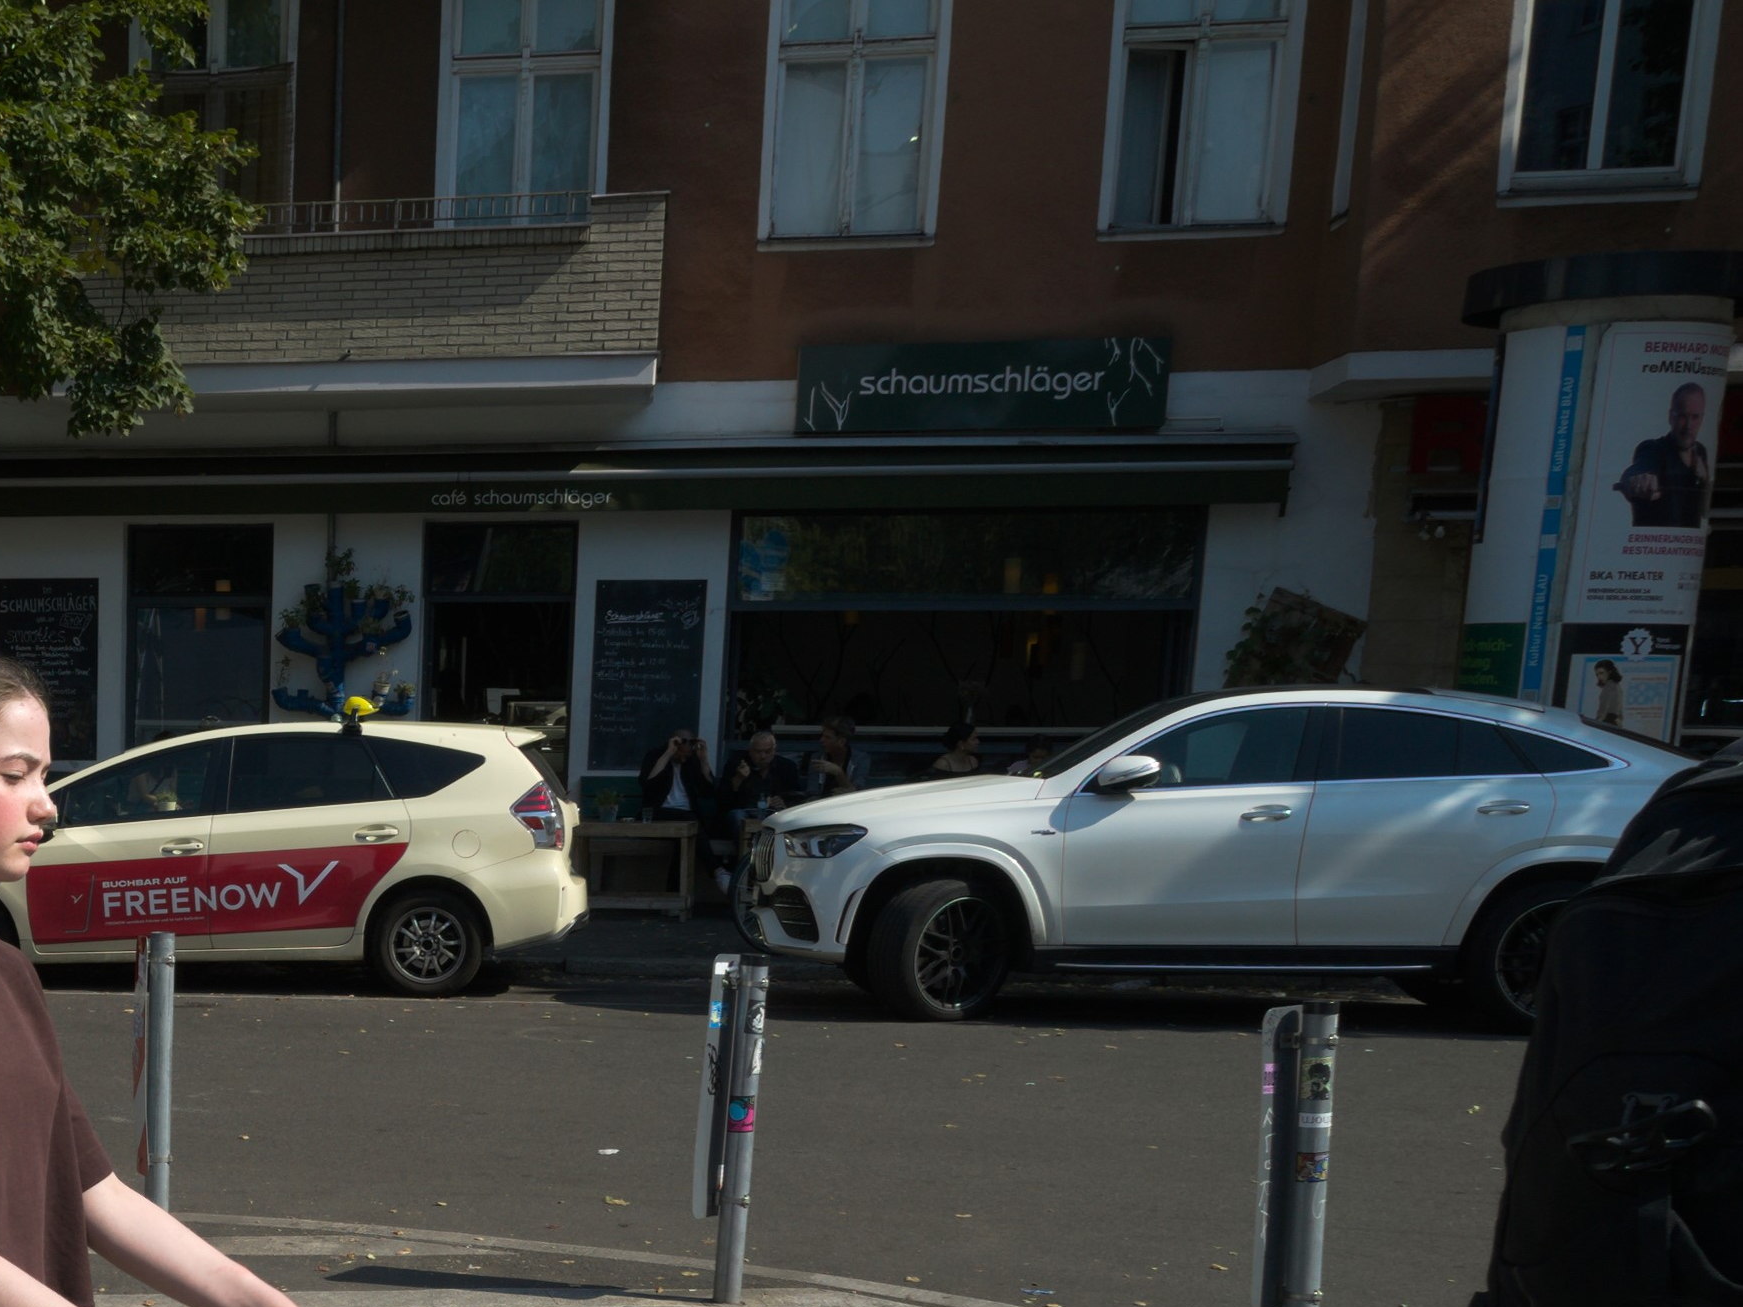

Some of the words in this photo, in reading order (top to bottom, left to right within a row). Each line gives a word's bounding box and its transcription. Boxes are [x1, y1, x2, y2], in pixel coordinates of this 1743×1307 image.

[1645, 341, 1708, 354] BERNHARD
[859, 365, 1106, 400] schaumschläger
[1560, 376, 1576, 408] BLAU
[431, 489, 467, 505] café
[474, 488, 613, 508] schaumschläger
[1589, 571, 1613, 581] BKA
[1617, 571, 1664, 580] THEATER
[1534, 574, 1549, 605] BLAU
[0, 593, 97, 613] SCHAUMSCHLÄGER
[102, 878, 160, 889] BUCHBAR
[164, 876, 188, 885] AUF
[102, 881, 282, 918] FREENOW
